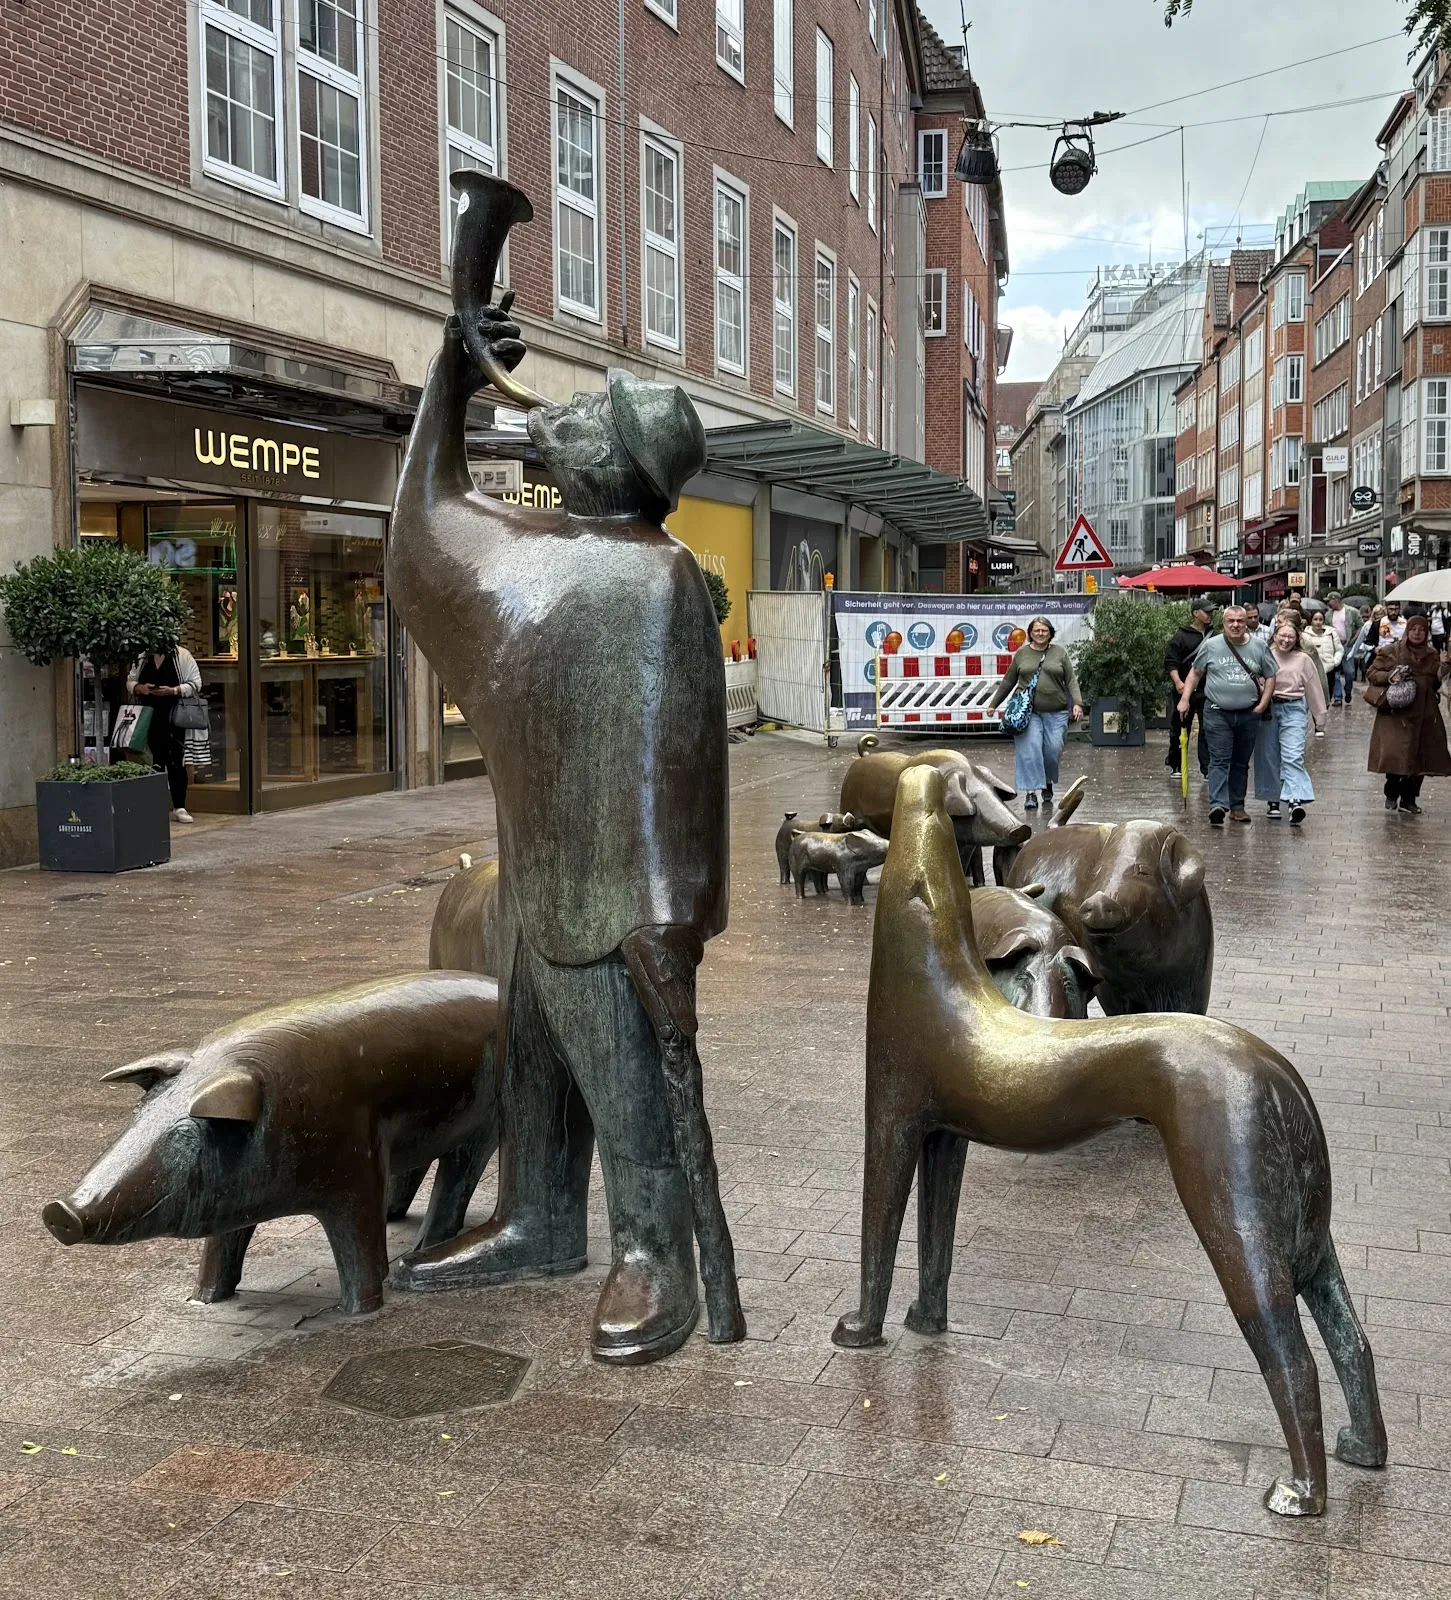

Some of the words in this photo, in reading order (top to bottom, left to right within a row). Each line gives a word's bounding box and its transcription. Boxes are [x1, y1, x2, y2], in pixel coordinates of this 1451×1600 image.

[195, 428, 320, 479] WEMPE
[1290, 576, 1303, 584] EIS
[844, 600, 881, 608] Sicherheit
[883, 601, 900, 610] geht
[917, 602, 955, 610] Deswegen
[1007, 603, 1044, 611] angelegter
[1045, 601, 1060, 609] PSA
